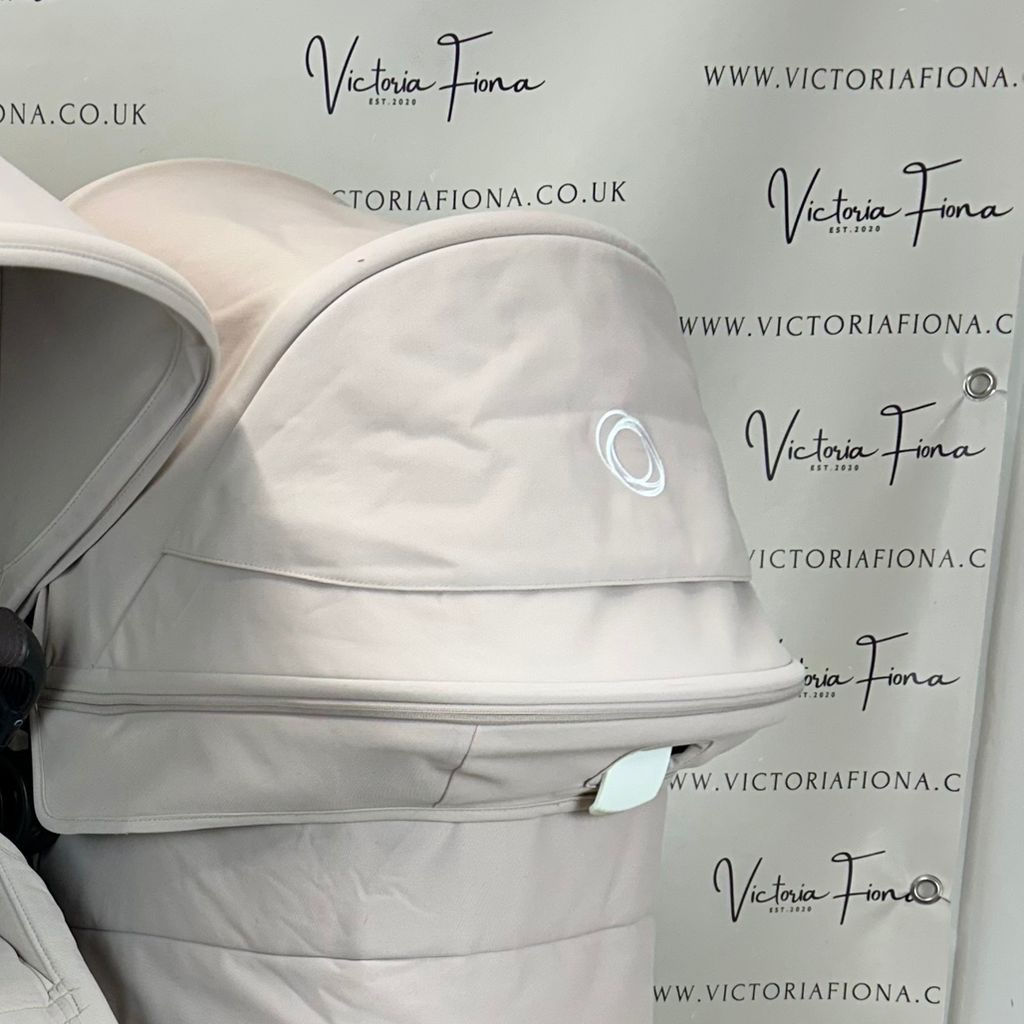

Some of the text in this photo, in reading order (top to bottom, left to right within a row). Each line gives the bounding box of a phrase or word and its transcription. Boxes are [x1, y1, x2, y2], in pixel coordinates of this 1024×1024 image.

[305, 31, 546, 122] Victoria Fiona
[703, 64, 1024, 91] WWW.VICTORIAFIONA.
[368, 97, 418, 106] EST.2020
[332, 180, 628, 211] TORIAFIONA.CO.UK
[768, 159, 1014, 247] Victoria Fiona
[828, 224, 882, 234] EST.2020
[679, 313, 1014, 337] WWW.VICTORIAFIONA.C
[745, 402, 986, 486] Victoria Fiona
[809, 463, 860, 472] EST.2020
[856, 632, 961, 711] Fiona
[713, 857, 831, 923] Victoria
